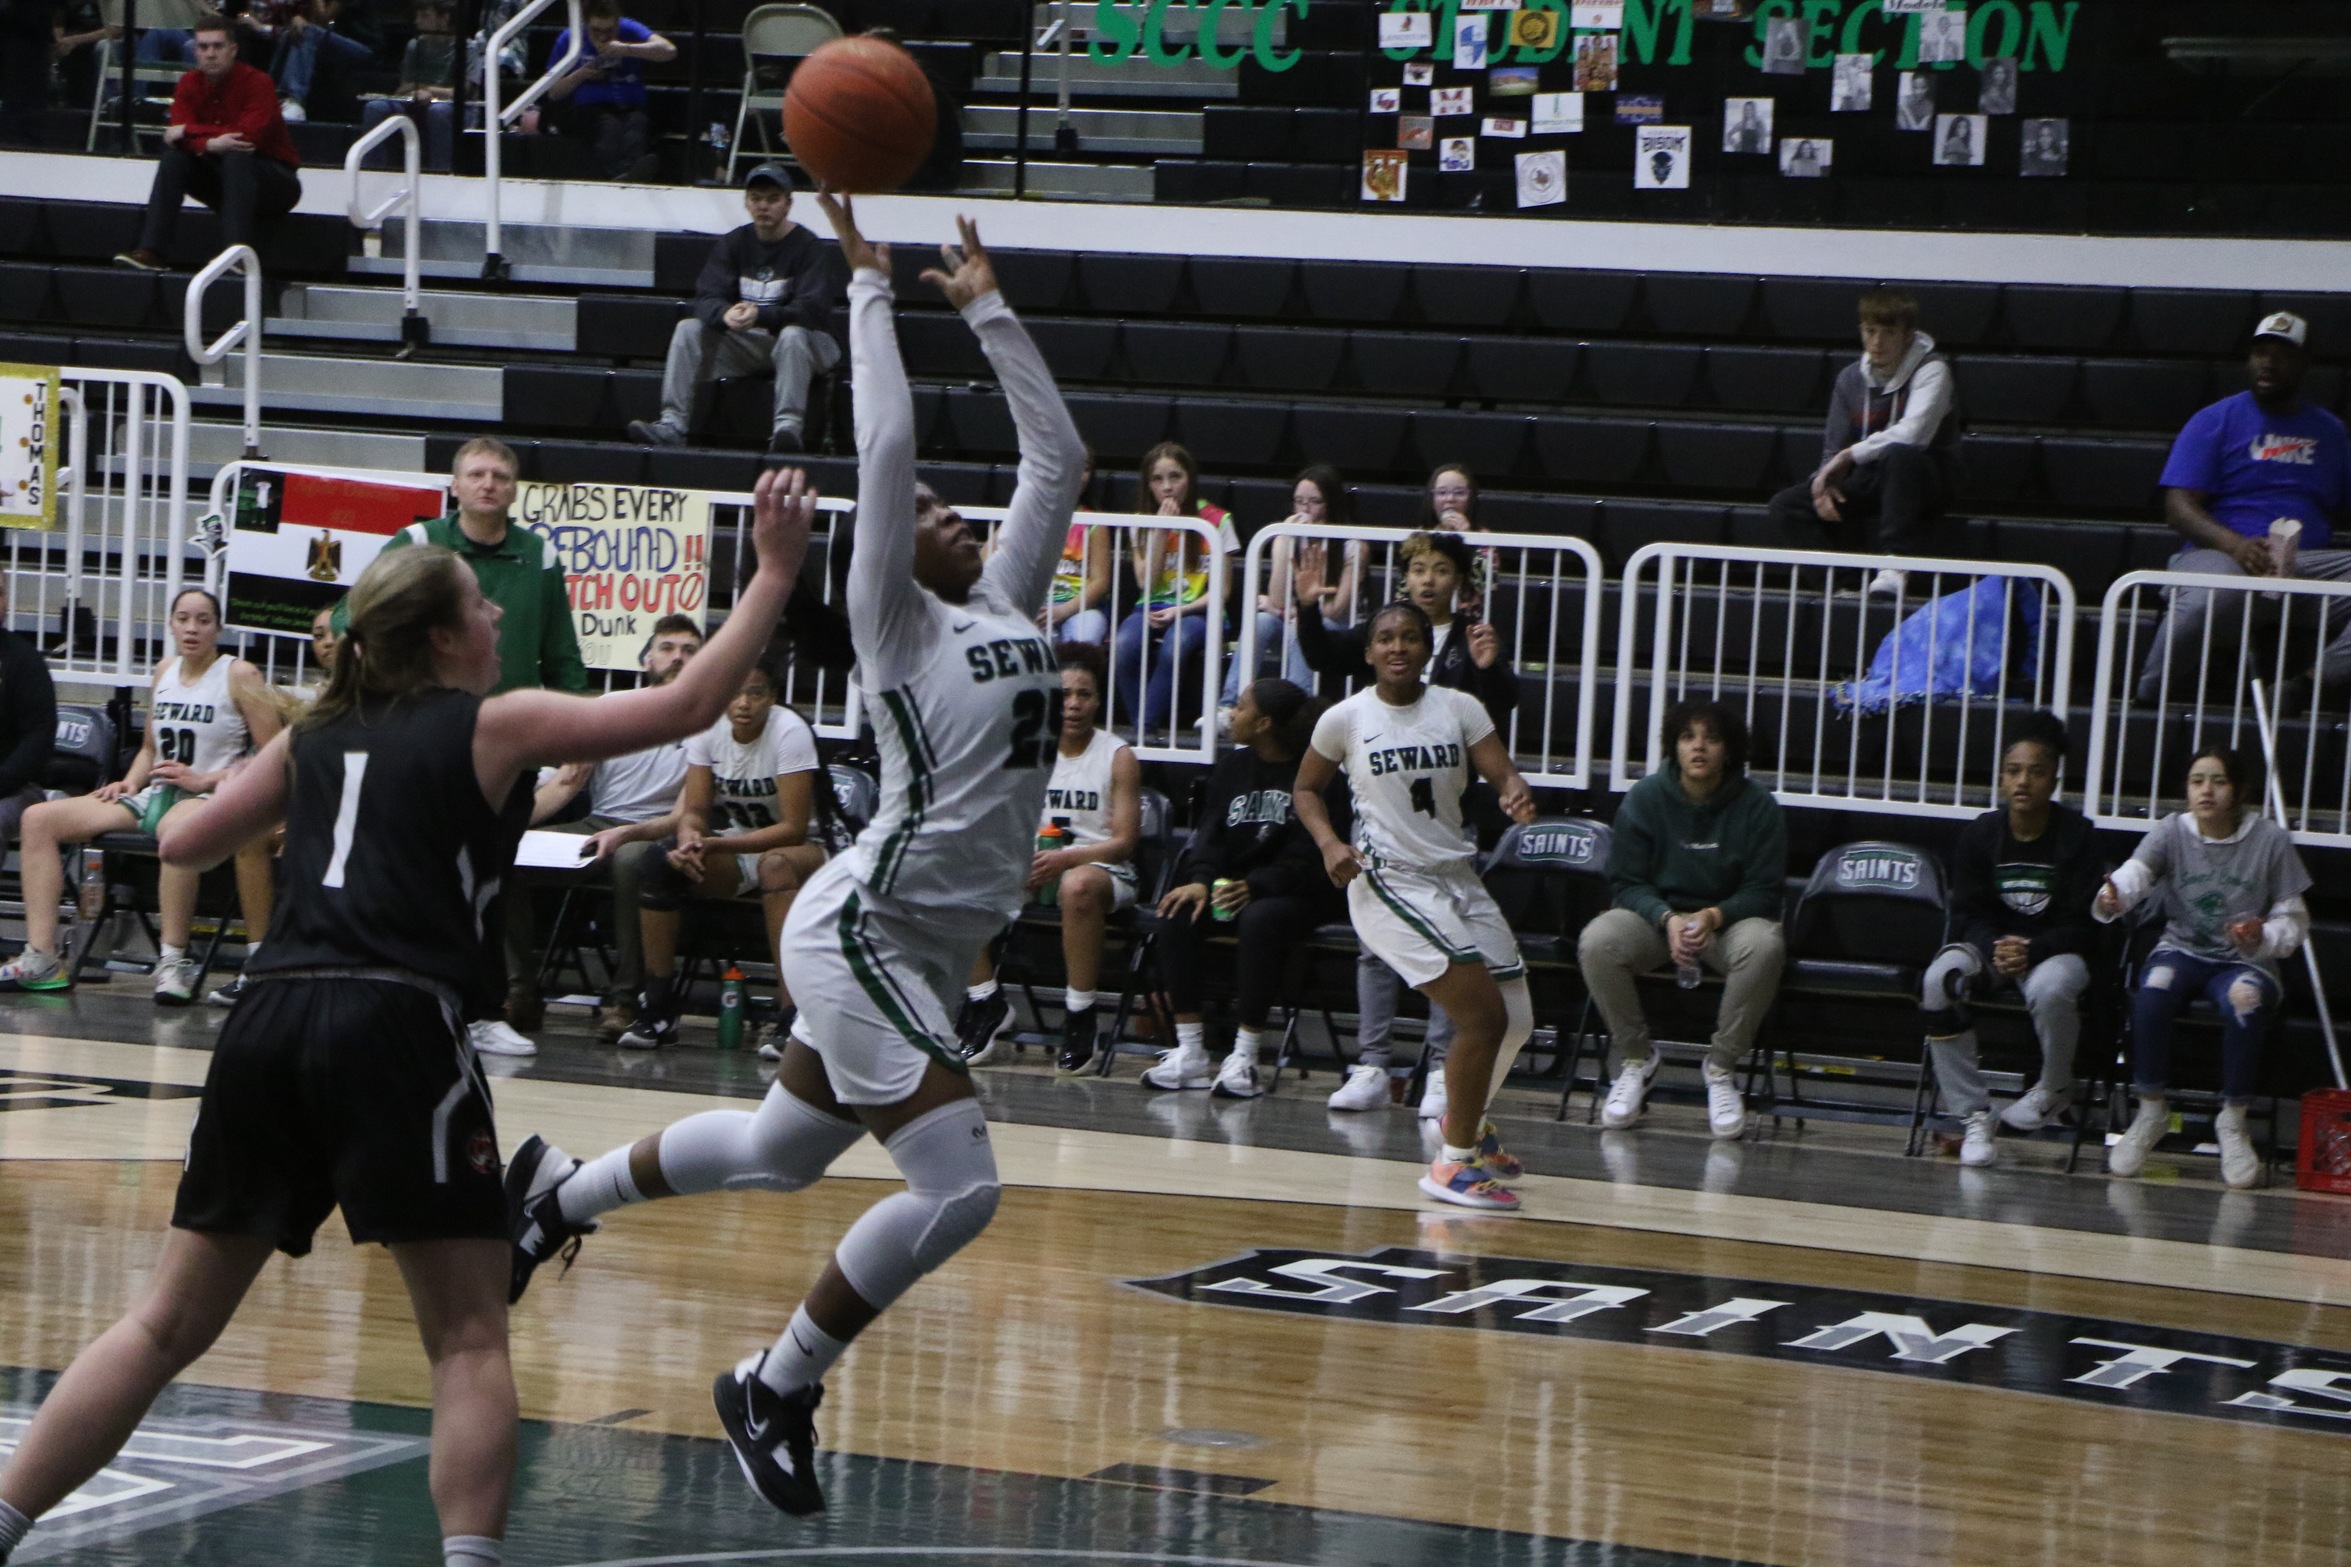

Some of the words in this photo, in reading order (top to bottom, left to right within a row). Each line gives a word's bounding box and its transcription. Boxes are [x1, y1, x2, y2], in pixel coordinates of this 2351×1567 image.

[1088, 0, 1309, 72] SCCC
[1383, 0, 1698, 67] TUDNT
[1744, 0, 2081, 72] SECTON
[29, 383, 46, 505] THOMAS
[523, 484, 607, 523] GRABS
[614, 487, 688, 522] EVERY
[565, 574, 614, 611] TCH
[619, 574, 682, 615] OUT
[582, 613, 637, 637] Dunk
[56, 721, 90, 742] NTS
[160, 727, 195, 766] 20
[1369, 743, 1460, 776] SEWARD
[712, 774, 777, 797] EWARD
[1045, 789, 1098, 811] WARD
[1409, 777, 1436, 819] 4
[321, 752, 369, 888] 1
[1227, 789, 1292, 827] SAINT
[1520, 833, 1592, 857] SAINTS
[1841, 858, 1916, 883] SAINTS
